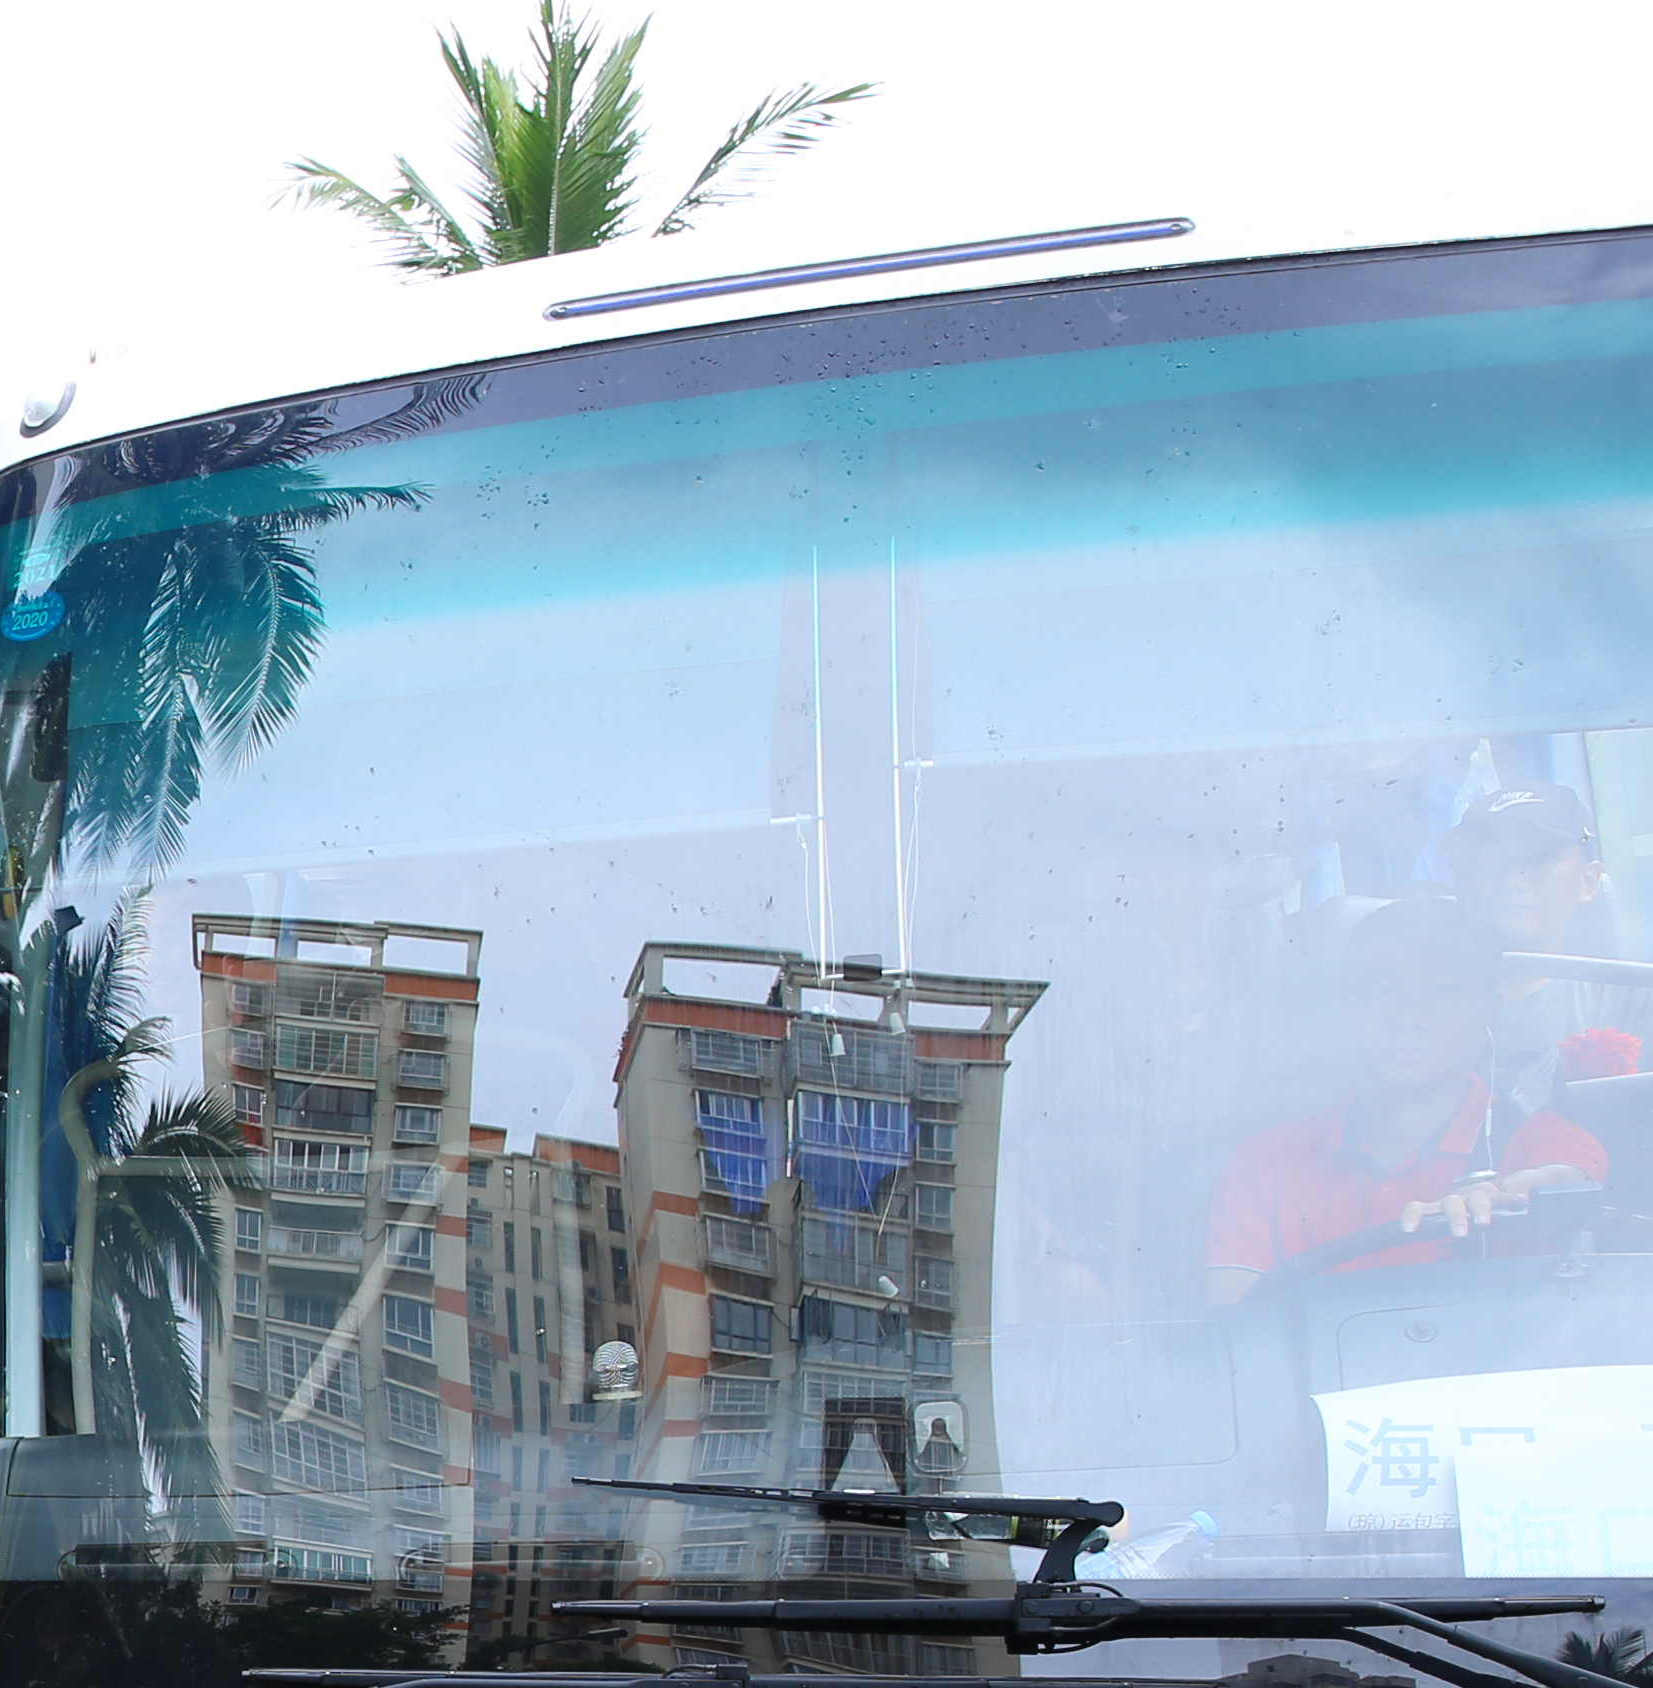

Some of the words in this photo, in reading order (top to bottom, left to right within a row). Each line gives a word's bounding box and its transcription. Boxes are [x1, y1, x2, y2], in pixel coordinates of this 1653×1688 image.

[13, 611, 48, 631] 2020
[1497, 791, 1534, 804] NIKE
[1343, 1417, 1535, 1498] 海
